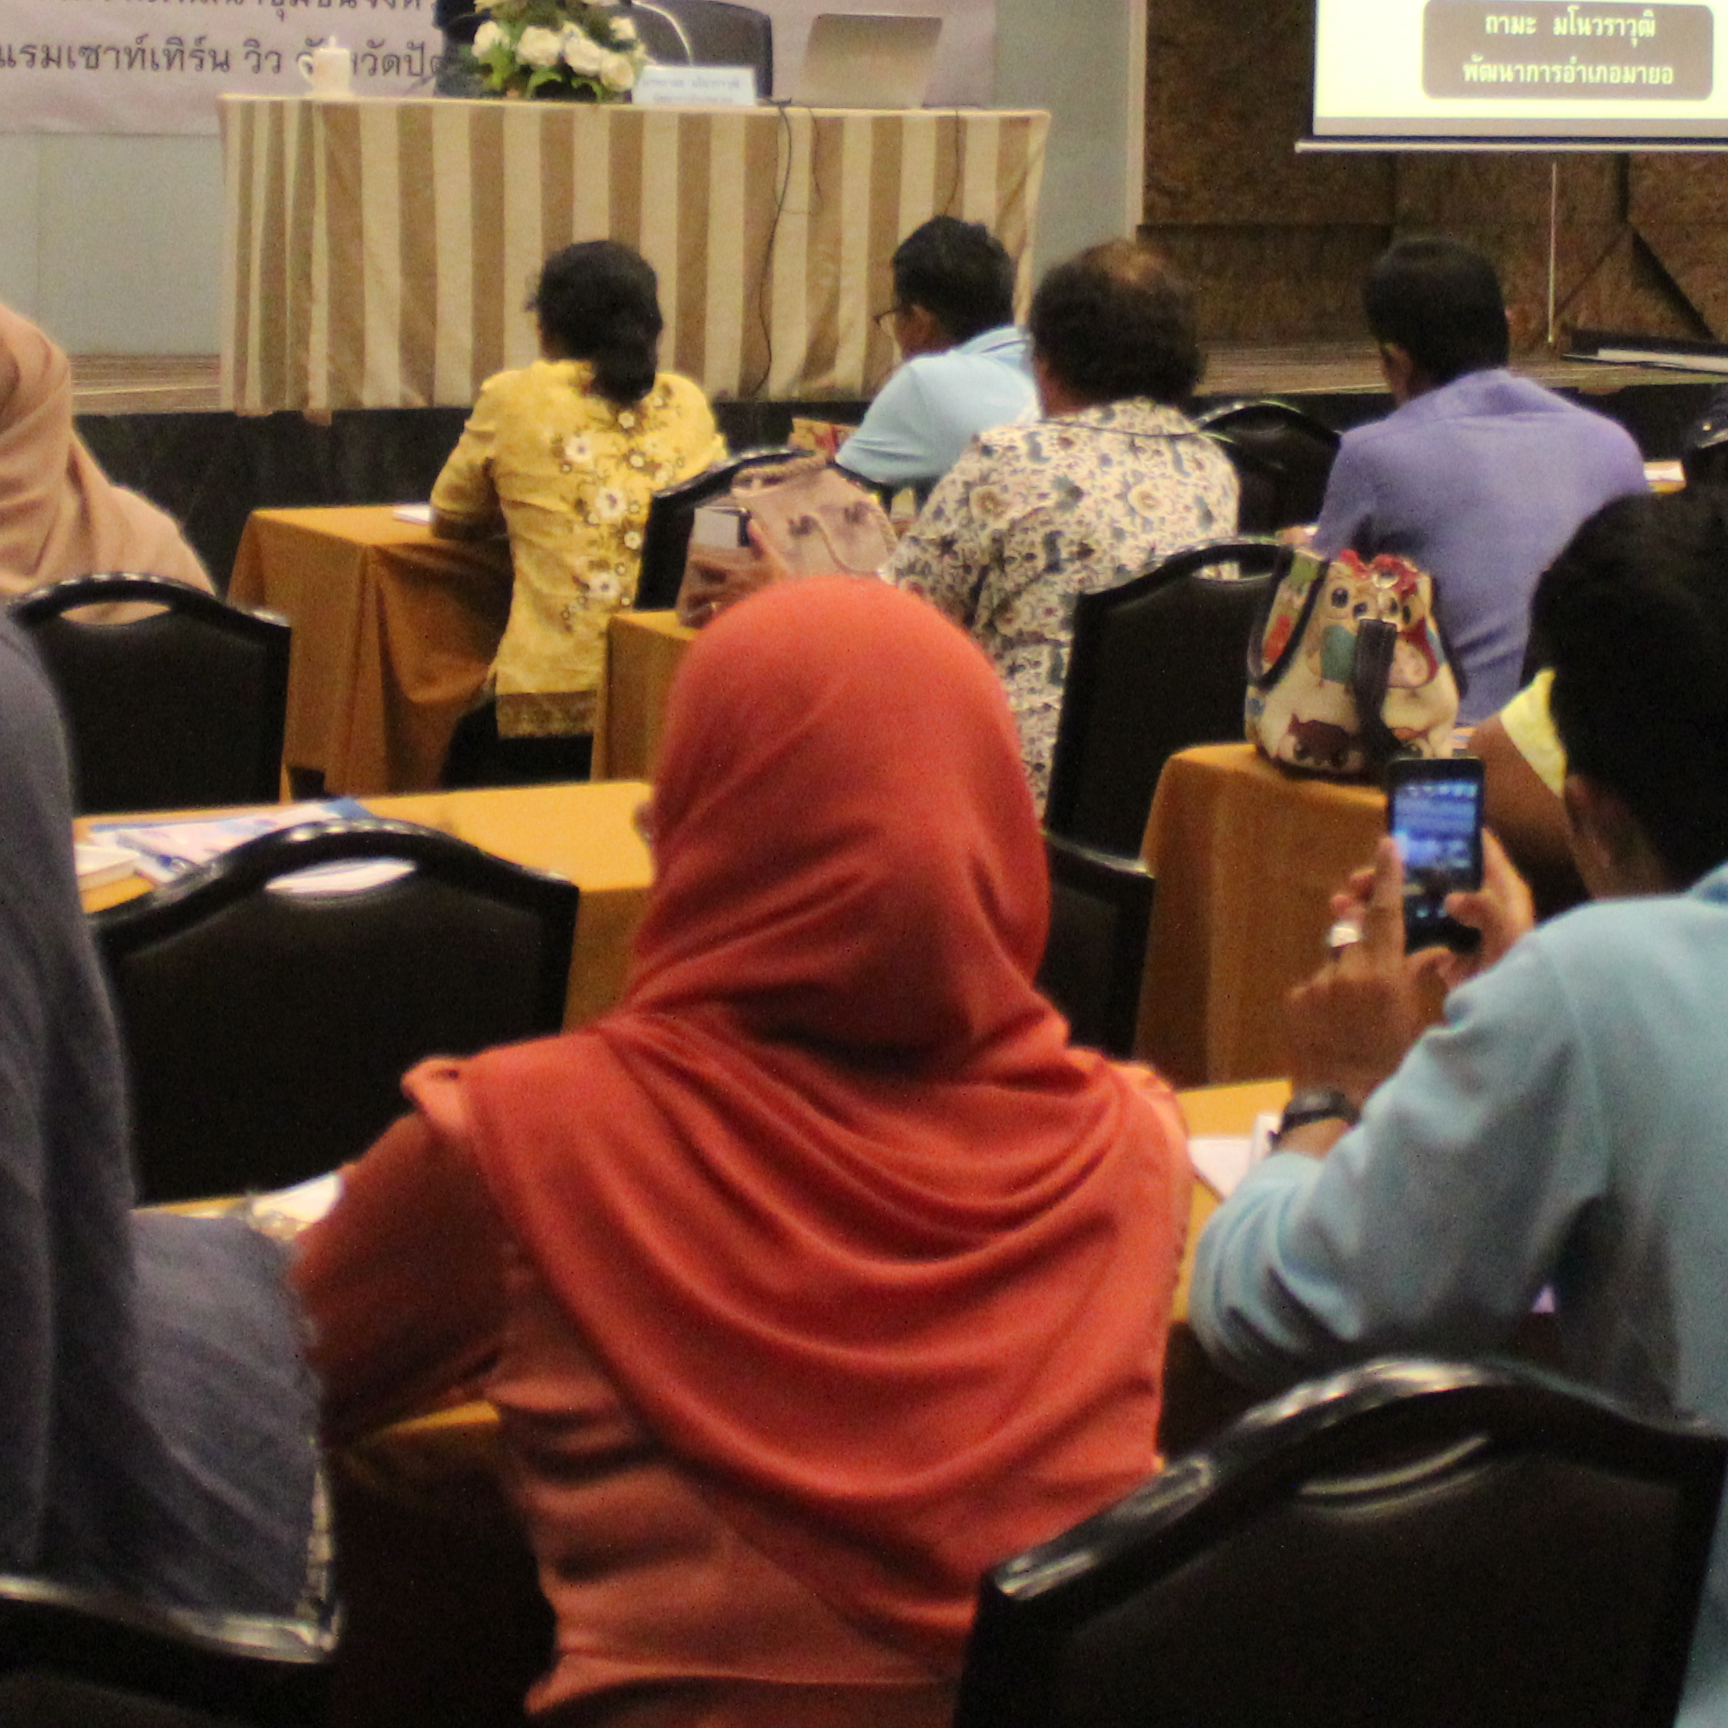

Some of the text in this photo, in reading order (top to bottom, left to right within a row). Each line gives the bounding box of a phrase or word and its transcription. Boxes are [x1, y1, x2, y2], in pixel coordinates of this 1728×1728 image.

[243, 36, 283, 75] วิว
[1462, 52, 1675, 86] พัฒนาการอำเภอมายอ
